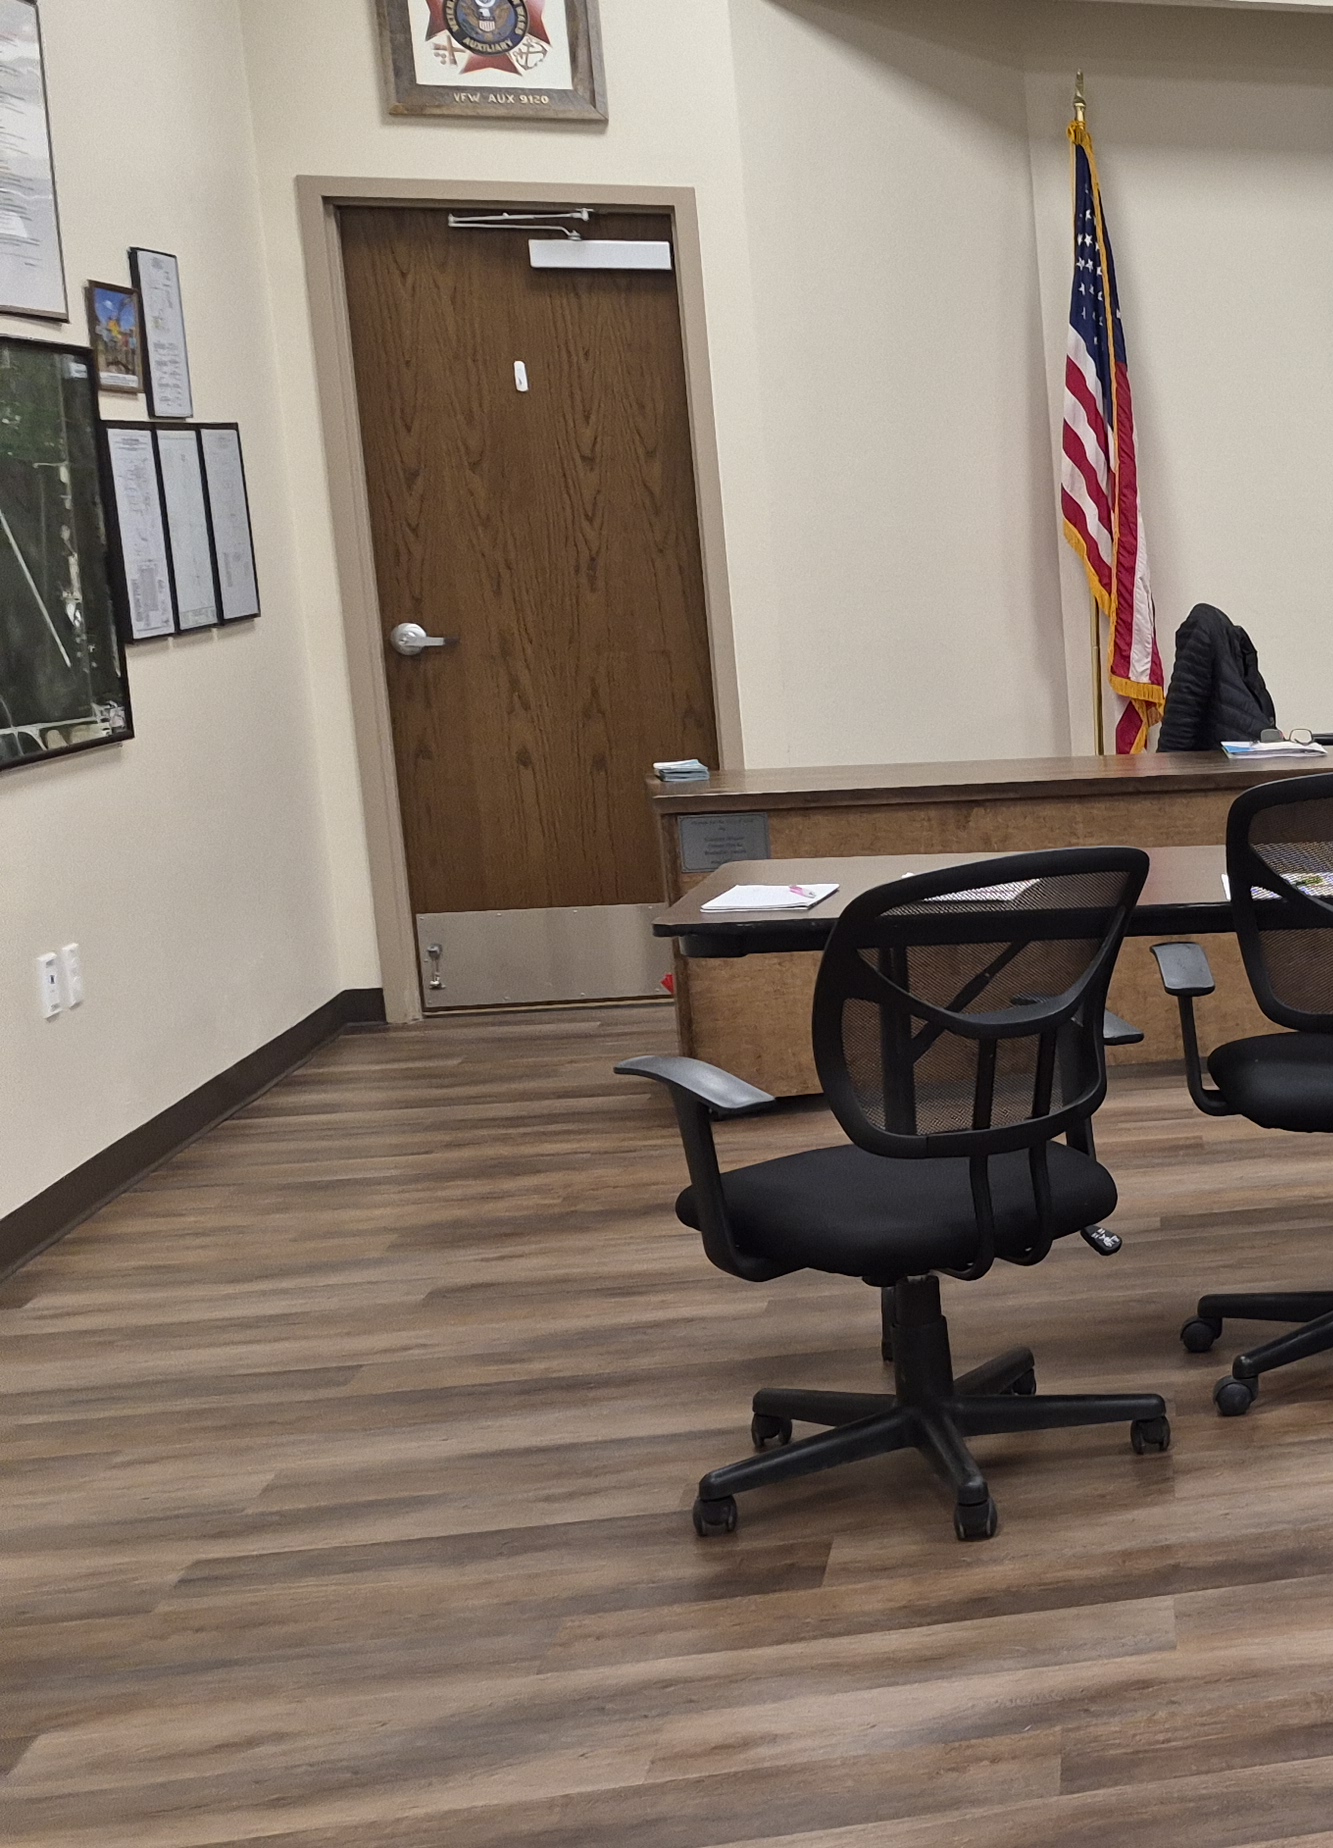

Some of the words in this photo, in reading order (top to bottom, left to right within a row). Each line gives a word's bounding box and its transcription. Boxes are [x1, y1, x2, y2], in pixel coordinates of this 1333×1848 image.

[462, 37, 514, 52] AUXILIARY
[453, 92, 481, 103] VFW
[488, 93, 515, 104] AUX
[519, 94, 549, 105] 9120
